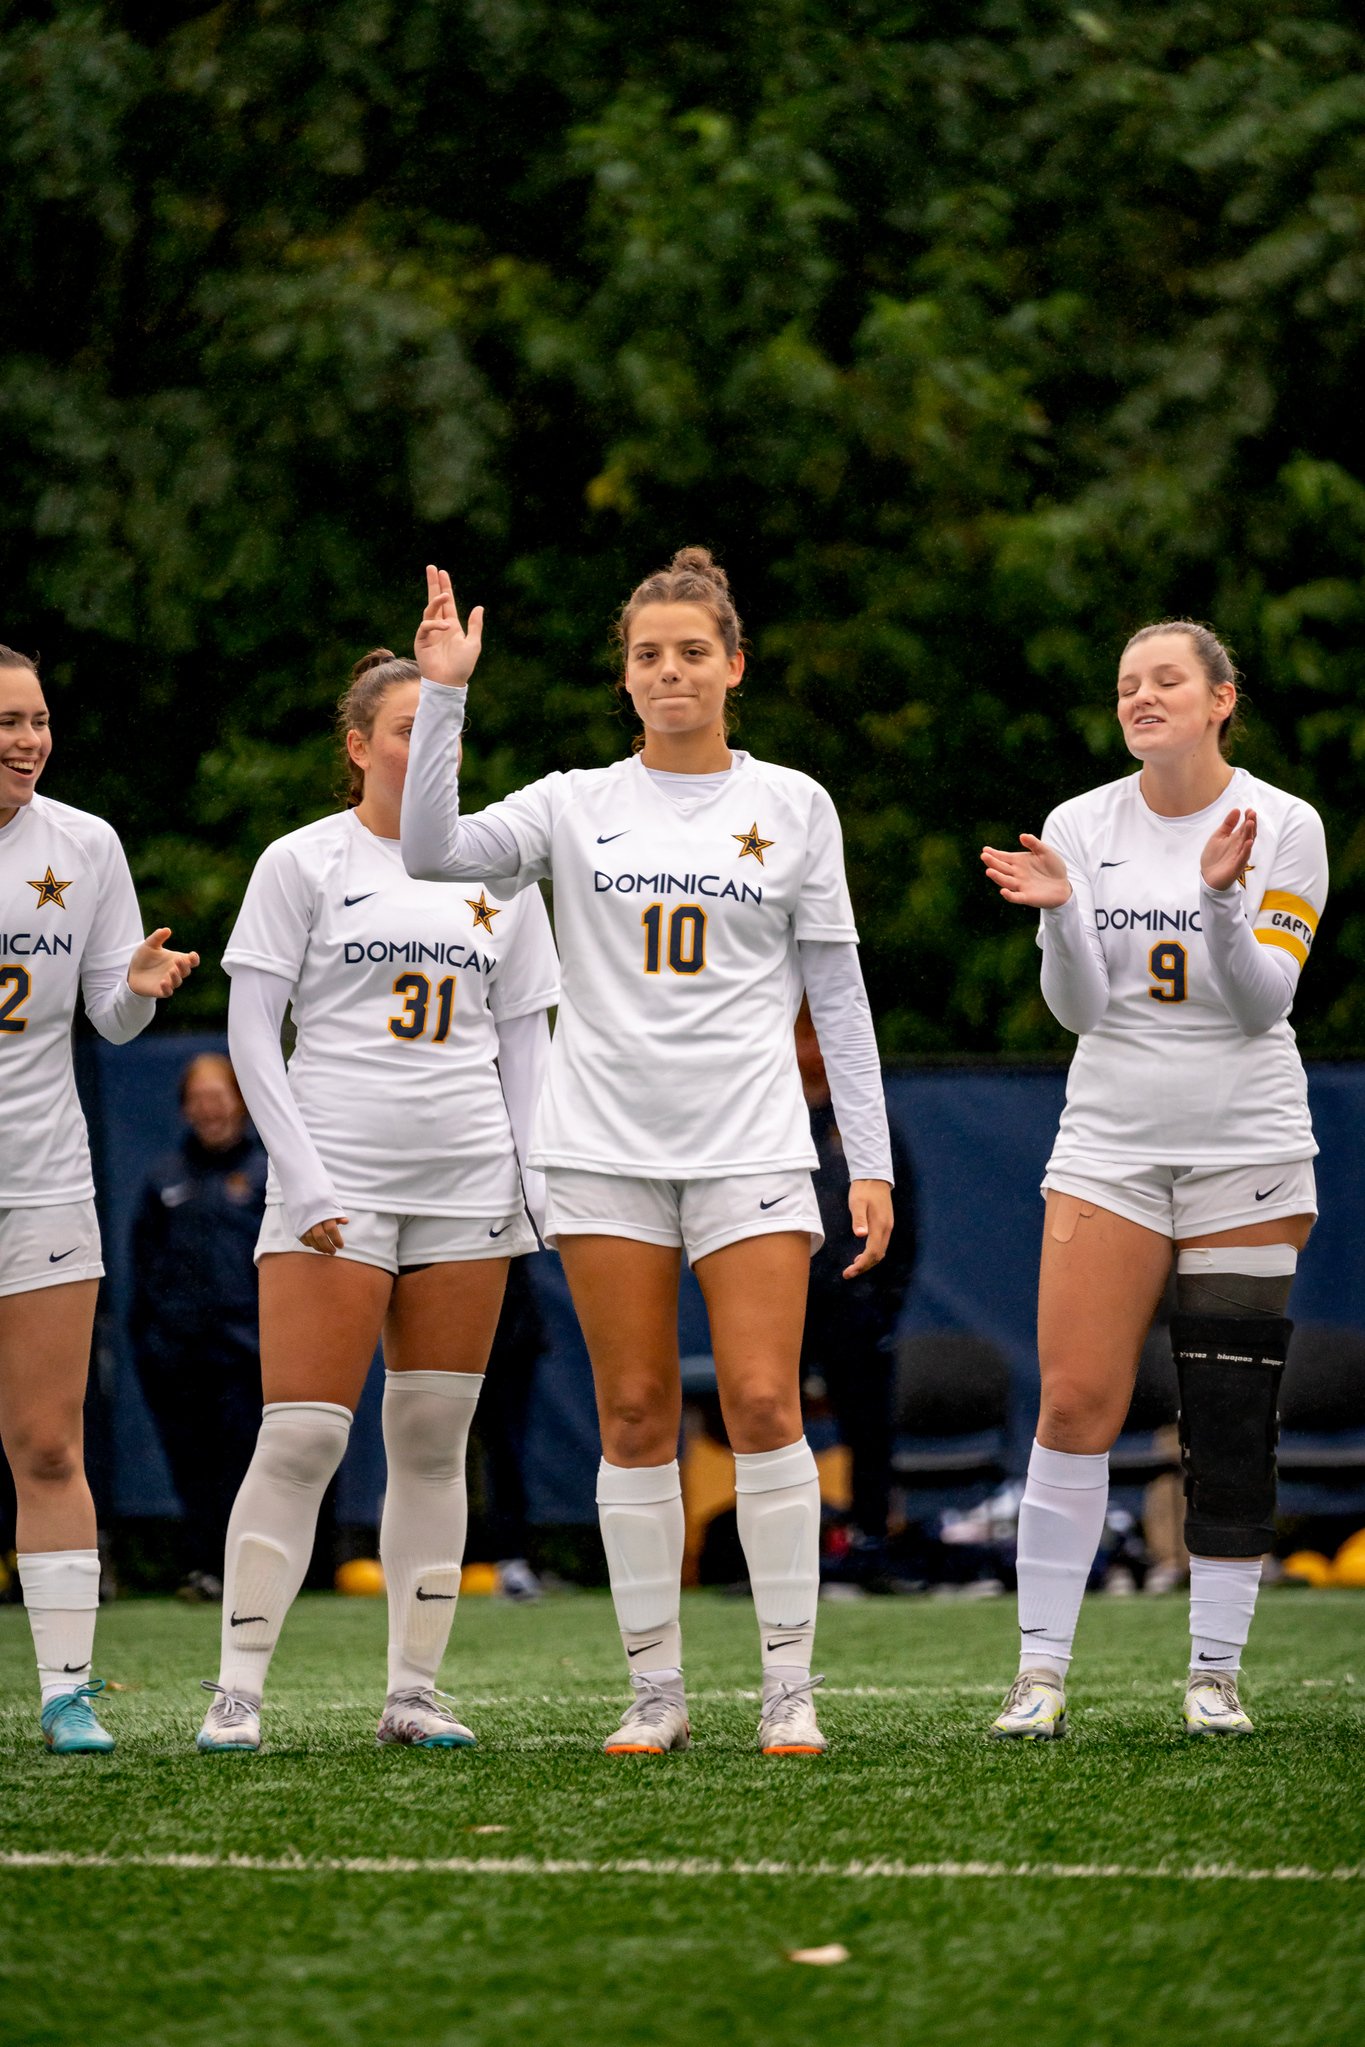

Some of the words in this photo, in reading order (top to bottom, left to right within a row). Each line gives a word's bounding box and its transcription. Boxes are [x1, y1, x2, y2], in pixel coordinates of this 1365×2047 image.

[594, 870, 763, 906] DOMINICAN
[1095, 908, 1203, 932] DOMINIC
[0, 933, 73, 956] ICAN
[641, 902, 708, 976] 10
[343, 940, 497, 976] DOMINICAN
[1148, 939, 1188, 1004] 9
[387, 971, 457, 1045] 31
